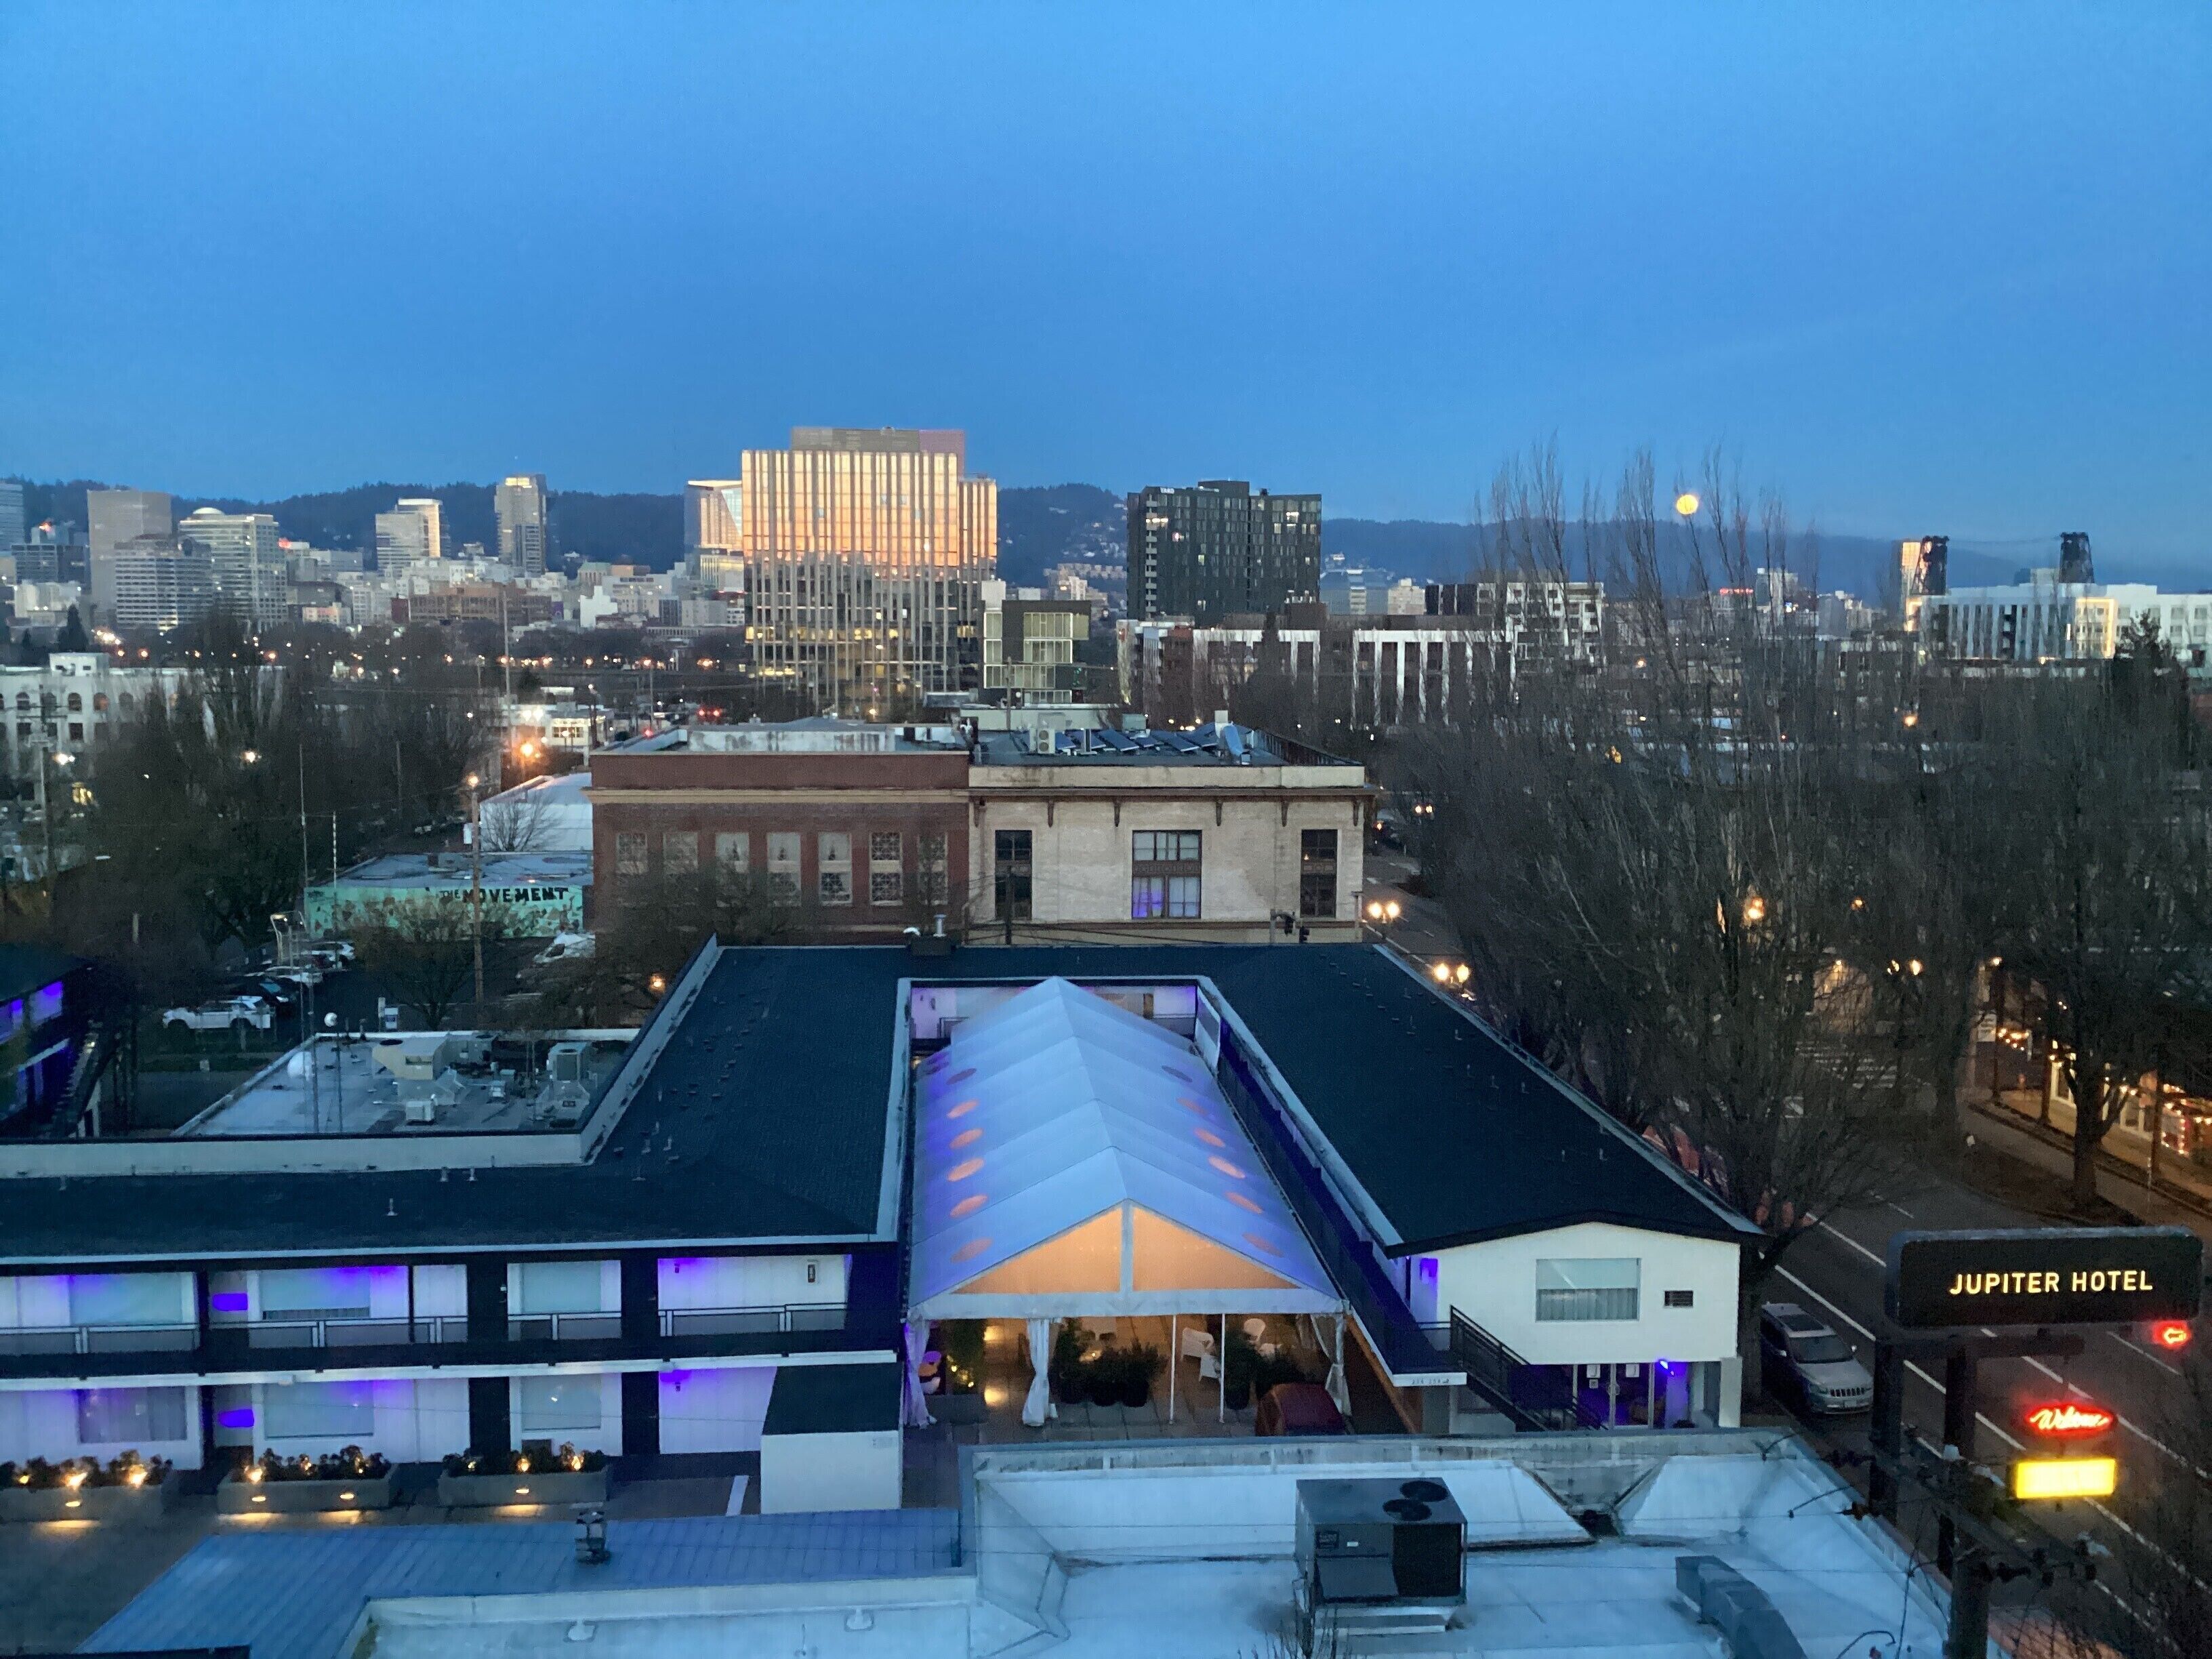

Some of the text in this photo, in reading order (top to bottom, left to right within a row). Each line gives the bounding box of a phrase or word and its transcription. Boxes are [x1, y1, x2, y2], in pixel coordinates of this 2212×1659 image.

[462, 887, 569, 903] MOVEMENT
[1949, 1270, 2153, 1295] JUPITER HOTEL
